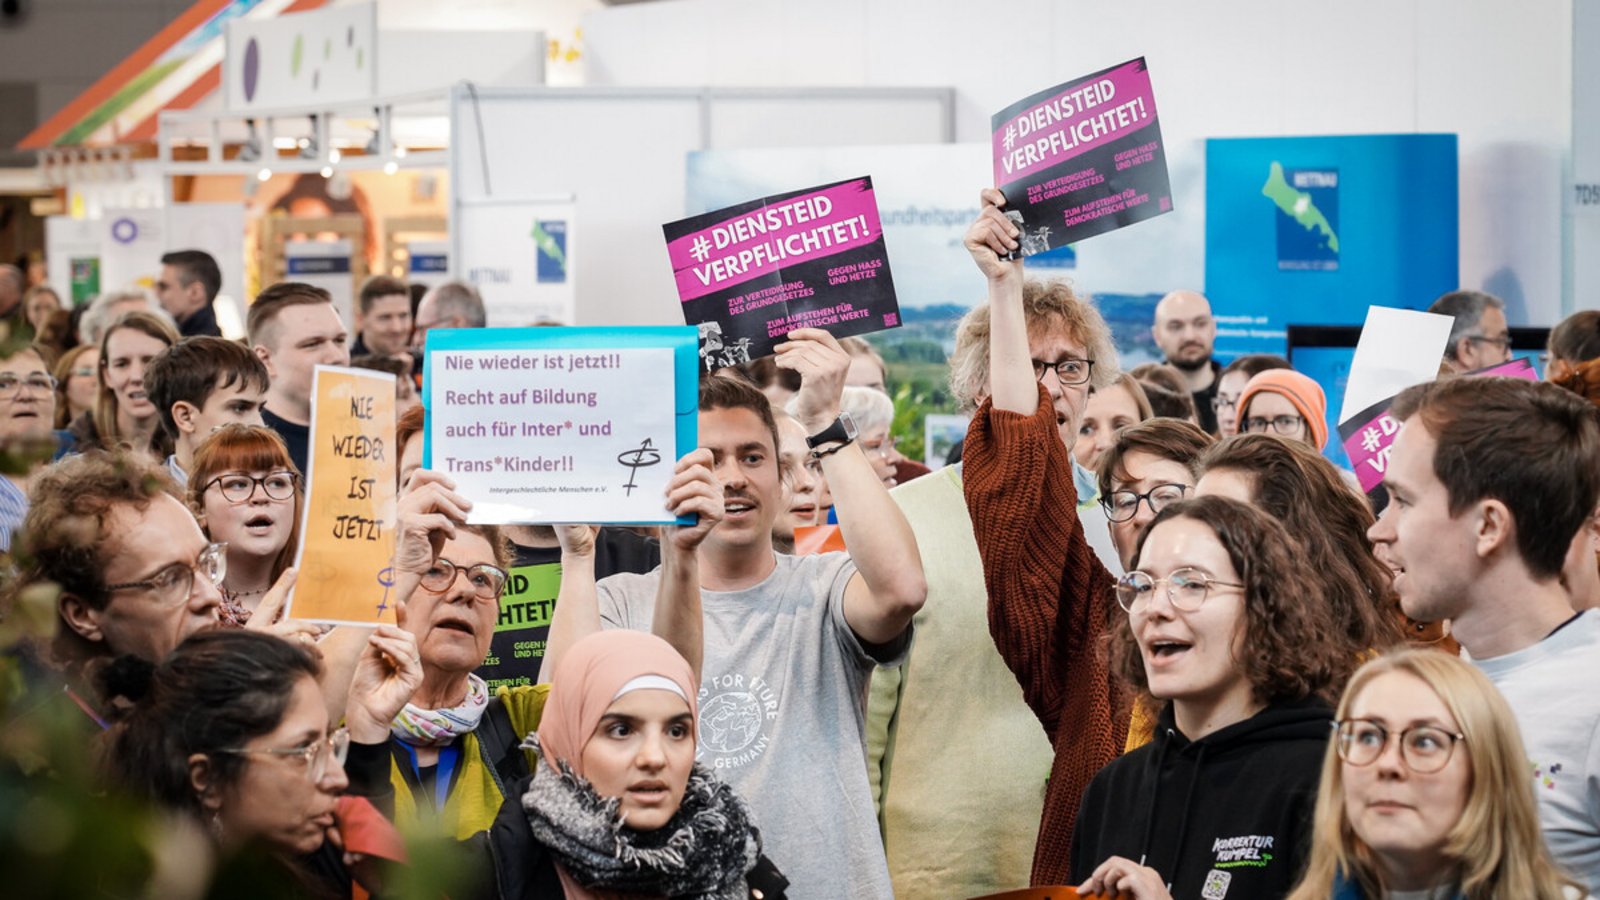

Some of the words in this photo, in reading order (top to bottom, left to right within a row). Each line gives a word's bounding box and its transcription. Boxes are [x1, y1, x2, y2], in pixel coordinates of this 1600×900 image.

[1002, 79, 1116, 151] #DIENSTEID
[1002, 96, 1147, 174] VERPFLICHTET!
[1114, 148, 1138, 162] GEGEN
[1138, 141, 1158, 154] HASS
[1115, 160, 1131, 171] UND
[1132, 152, 1153, 165] HETZE
[1026, 184, 1042, 196] ZUR
[1042, 168, 1096, 190] VERTEIDIGUNG
[1029, 194, 1043, 205] DES
[1043, 174, 1104, 199] GRUNDGESETZES
[1063, 206, 1080, 218] ZUM
[1082, 193, 1122, 212] AUFSTEHEN
[1122, 188, 1136, 199] FÜR
[1065, 201, 1125, 227] DEMOKRATISCHE
[1125, 193, 1149, 208] WERTE
[689, 196, 832, 263] #DIENSTEID
[693, 214, 870, 286] VERPFLICHTET!
[827, 264, 857, 277] GEGEN
[858, 259, 882, 271] HASS
[829, 275, 848, 286] UND
[849, 269, 877, 281] HETZE
[728, 295, 744, 307] ZUR
[745, 281, 804, 302] VERTEIDIGUNG
[729, 306, 745, 316] DES
[745, 287, 815, 311] GRUNDGESETZES
[766, 318, 785, 329] ZUM
[786, 307, 835, 322] AUFSTEHEN
[836, 302, 853, 313] FÜR
[768, 315, 839, 338] DEMOKRATISCHE
[840, 309, 870, 321] WERTE
[445, 355, 474, 370] Nie
[479, 354, 539, 370] wieder
[544, 354, 564, 370] ist
[568, 354, 621, 373] jetzt!!
[350, 396, 374, 419] NIE
[445, 389, 494, 405] Recht
[499, 388, 527, 404] auf
[532, 388, 597, 407] Bildung
[445, 421, 486, 437] auch
[492, 421, 517, 437] für
[579, 420, 612, 436] und
[1361, 415, 1402, 452] #D
[332, 435, 385, 462] WIEDER
[347, 476, 376, 500] IST
[489, 485, 557, 495] Intergeschlechtliche
[559, 485, 593, 493] Menschen
[333, 515, 384, 541] JETZT
[502, 574, 529, 596] ID
[514, 641, 540, 650] GEGEN
[514, 650, 531, 658] UND
[711, 674, 743, 690] FOR
[714, 733, 770, 768] GERMANY
[1212, 835, 1274, 852] KORREKTUR
[1216, 848, 1261, 861] KUMPEL
